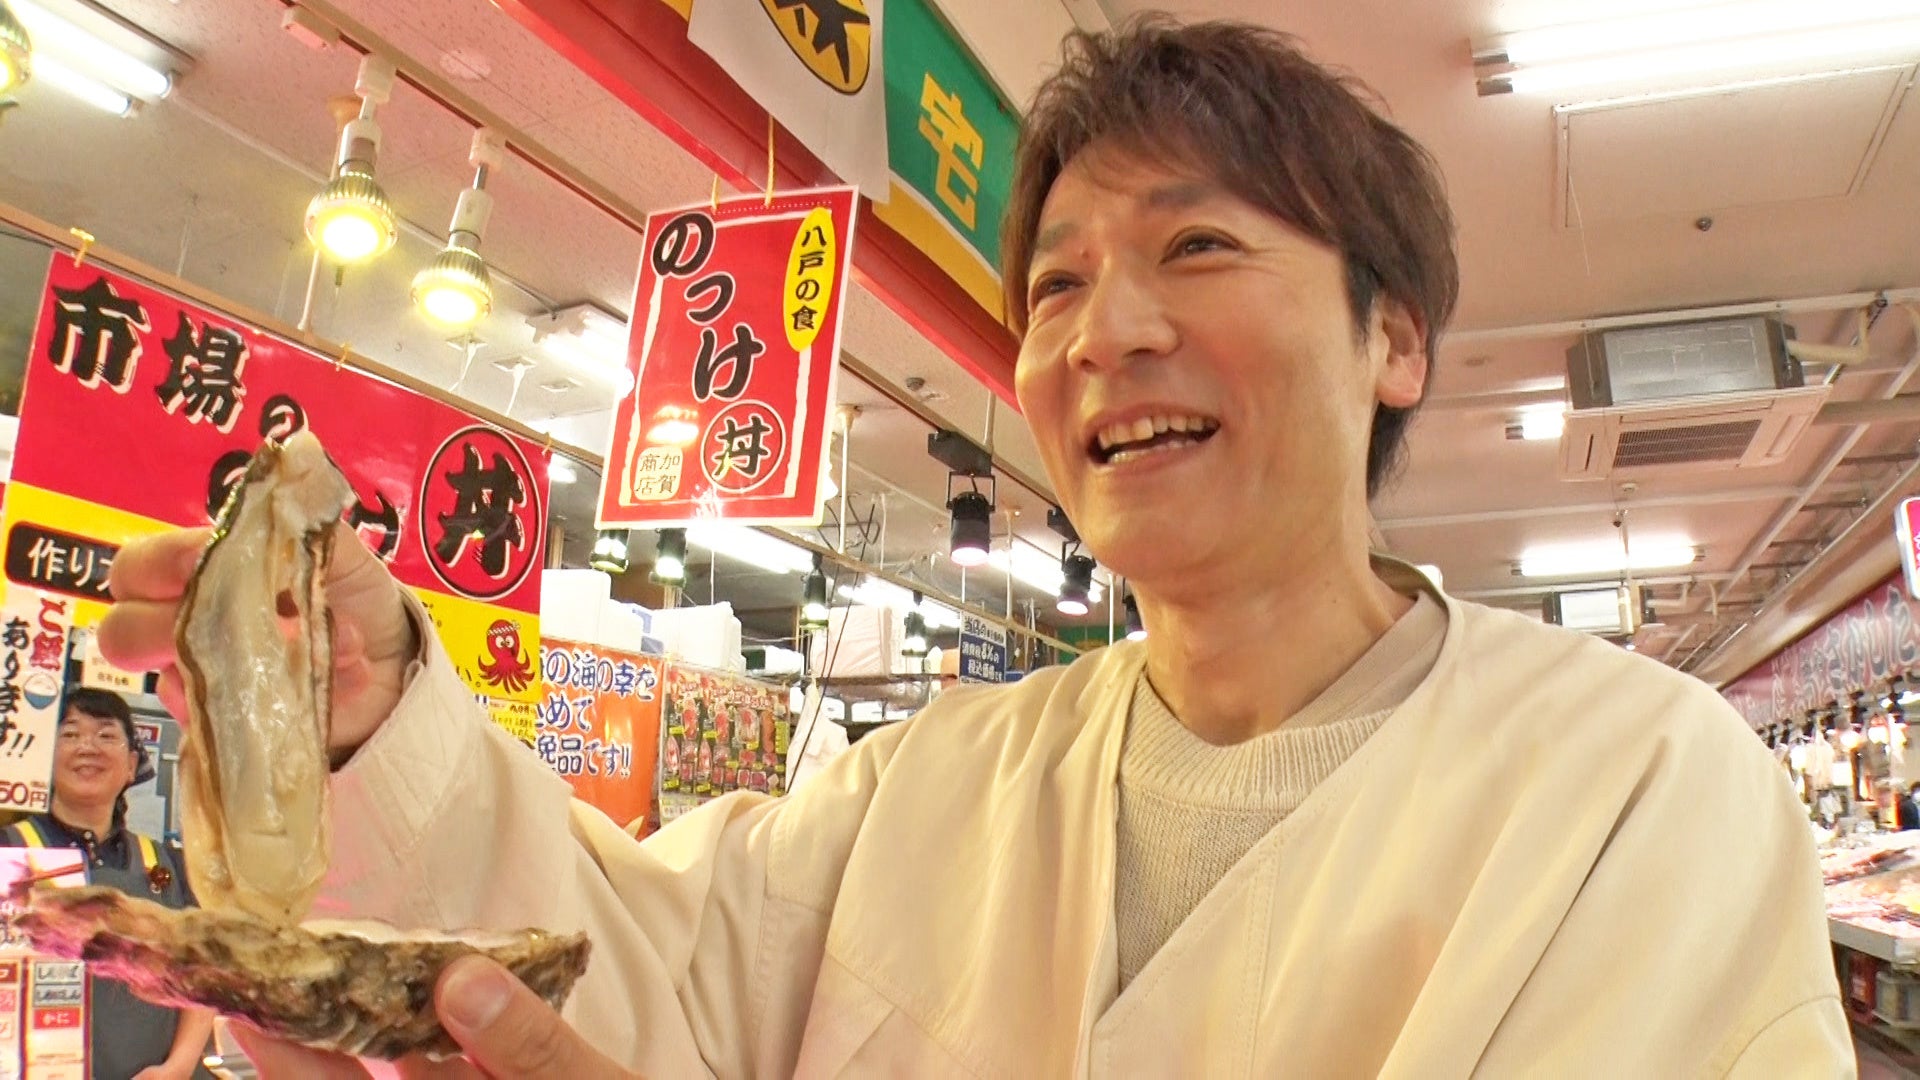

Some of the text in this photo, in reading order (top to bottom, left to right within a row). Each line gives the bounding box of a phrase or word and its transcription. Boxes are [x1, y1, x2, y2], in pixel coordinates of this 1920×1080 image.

[917, 71, 985, 232] 宅
[651, 210, 772, 479] のっけ丼
[790, 224, 828, 332] 八戸の食
[50, 277, 310, 444] 市場の
[540, 648, 656, 700] の海の幸を
